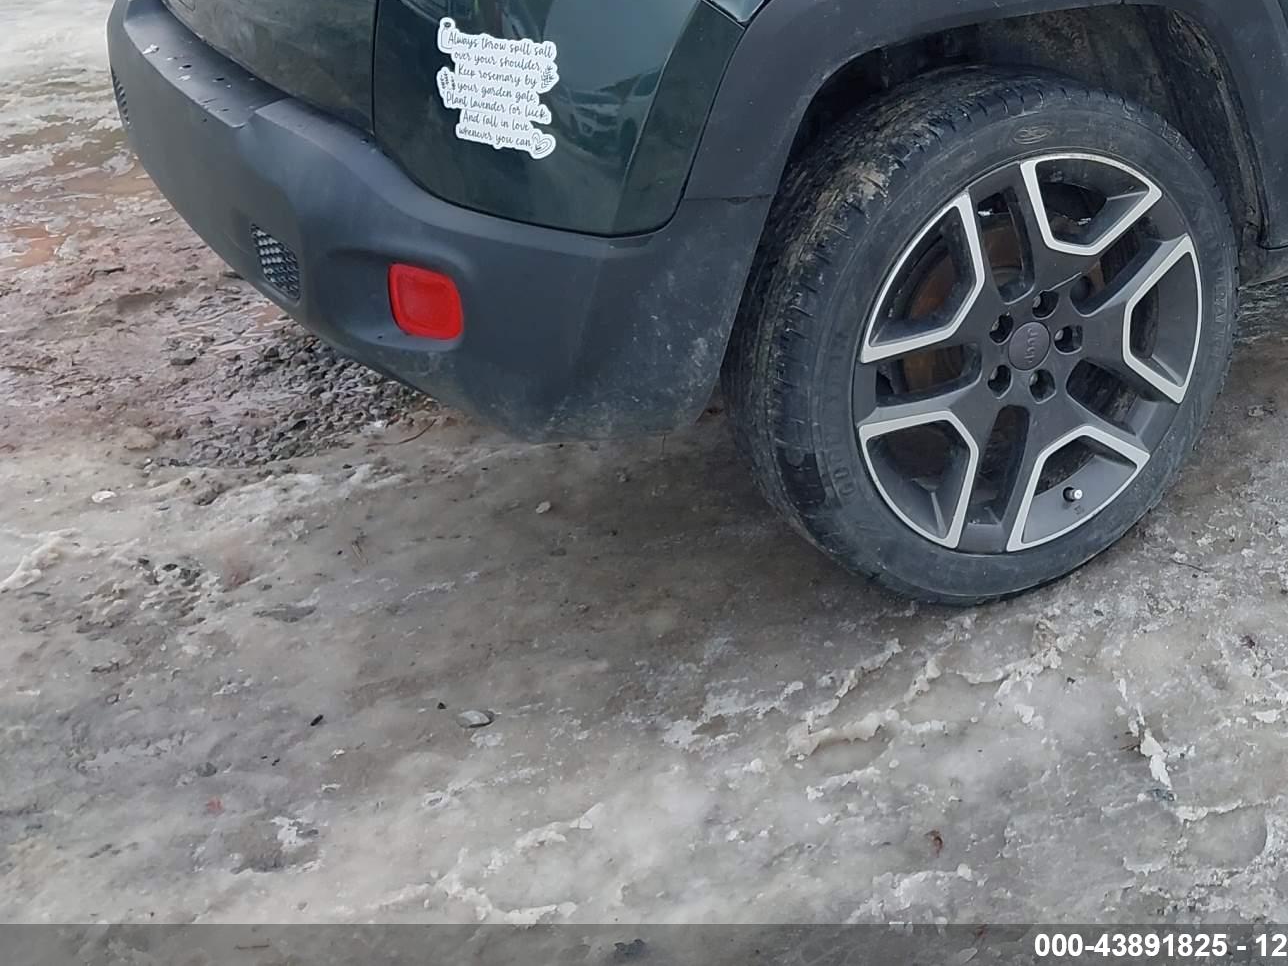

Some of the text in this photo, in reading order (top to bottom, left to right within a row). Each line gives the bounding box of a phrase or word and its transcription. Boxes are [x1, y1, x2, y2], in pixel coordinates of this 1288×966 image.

[448, 34, 478, 48] Always
[481, 37, 506, 50] throw
[454, 52, 471, 61] over
[474, 55, 497, 65] your
[458, 65, 537, 89] Keep rosemary by
[457, 82, 478, 93] your
[481, 87, 512, 98] garden
[446, 91, 468, 107] Plant
[470, 97, 505, 113] lavender
[509, 104, 522, 115] for
[462, 111, 530, 131] And fall in love
[495, 135, 514, 147] you
